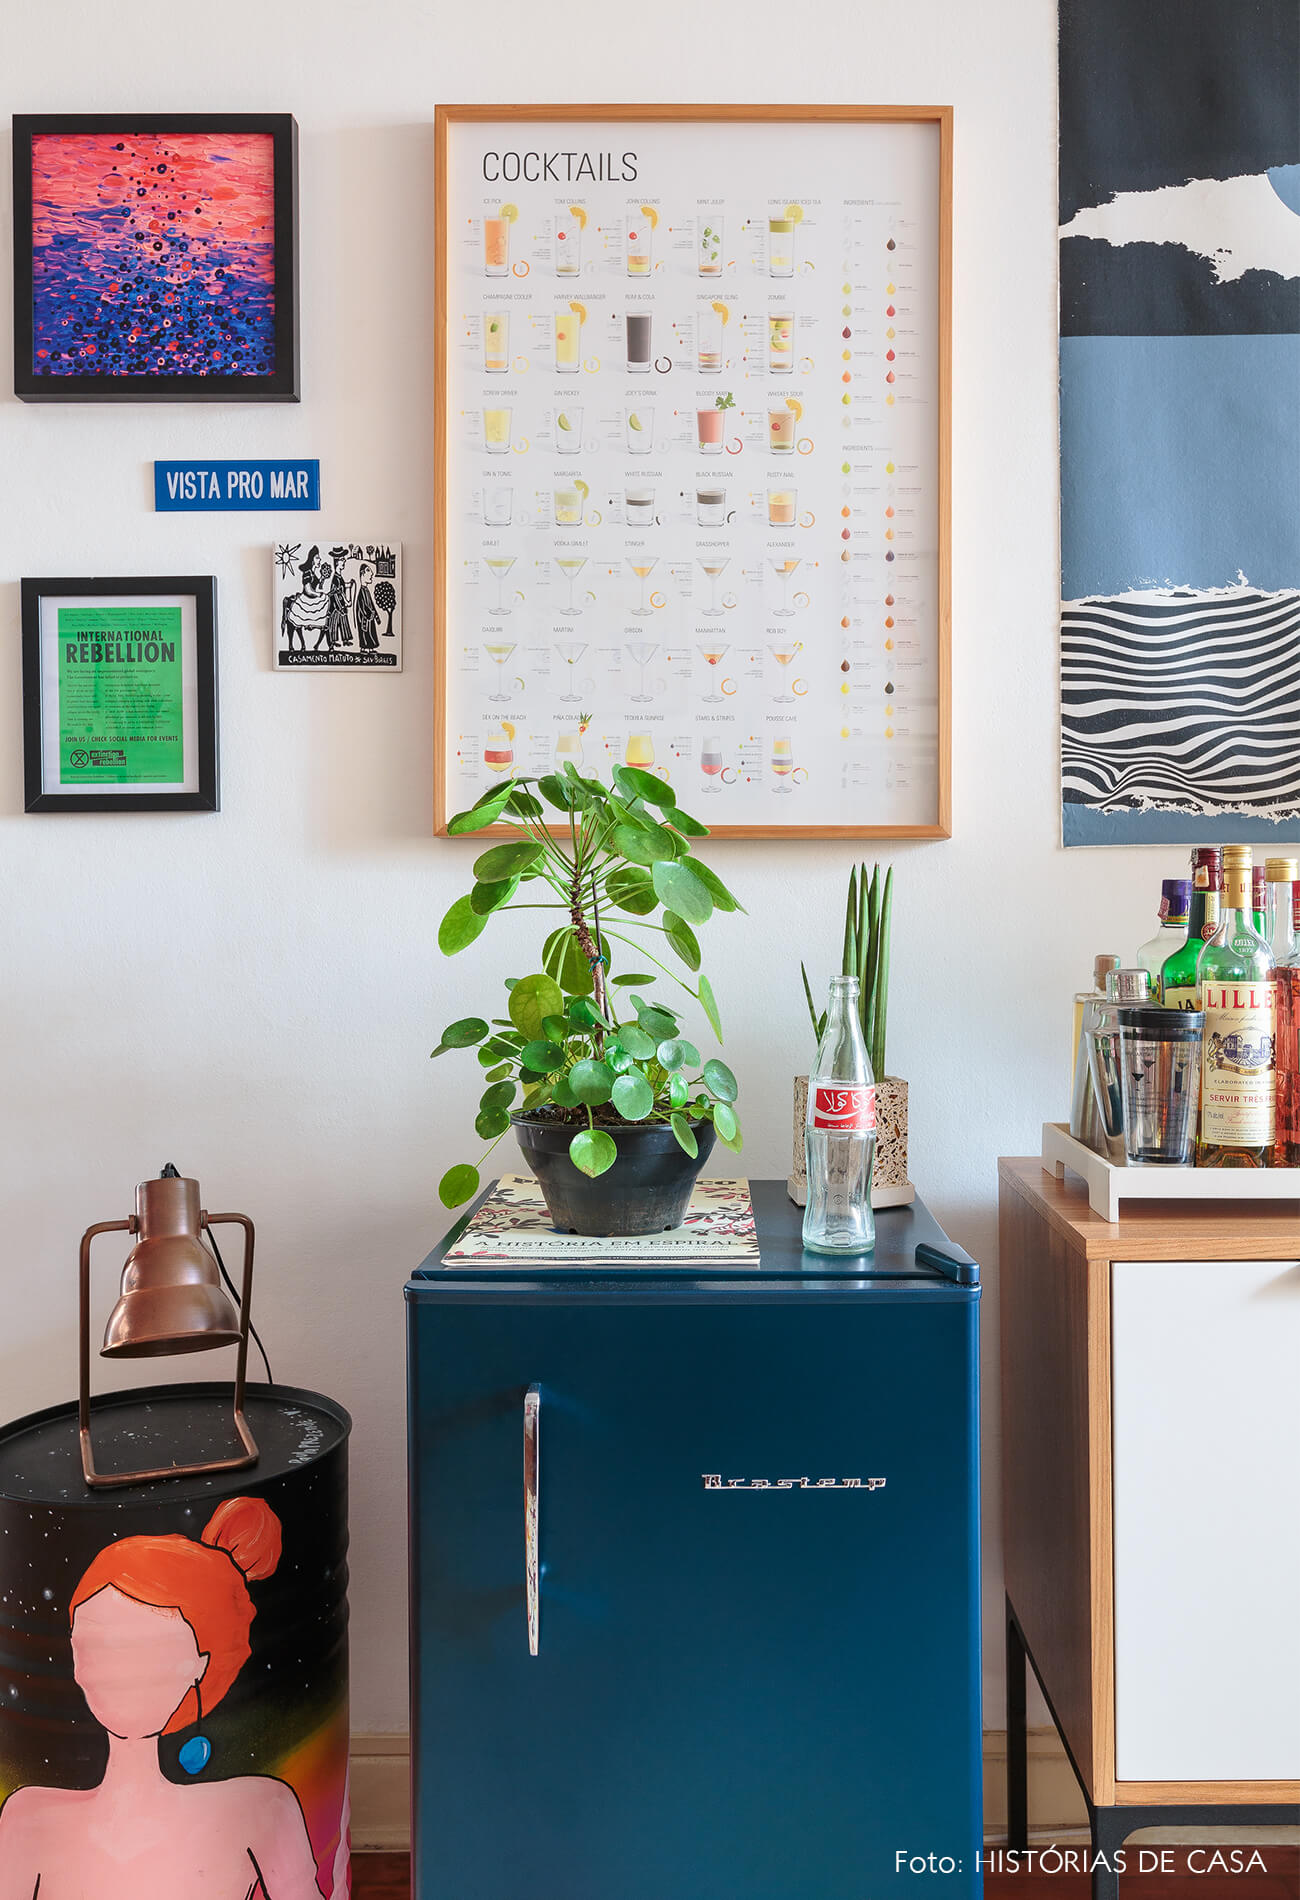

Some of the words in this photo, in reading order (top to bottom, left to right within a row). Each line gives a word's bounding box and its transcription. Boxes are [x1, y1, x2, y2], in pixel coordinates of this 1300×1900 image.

[483, 151, 638, 182] COCKTAILS
[166, 471, 221, 500] VISTA
[227, 470, 264, 499] PRO
[270, 470, 309, 499] MAR
[77, 631, 164, 642] INTERNATIONAL
[66, 642, 175, 663] REBELLION
[288, 654, 327, 664] CASAMENTO
[328, 654, 354, 663] MATUTO
[1209, 1094, 1240, 1103] SERVIR
[497, 1239, 603, 1247] HISTÓRIA
[702, 1474, 887, 1491] Brastemp
